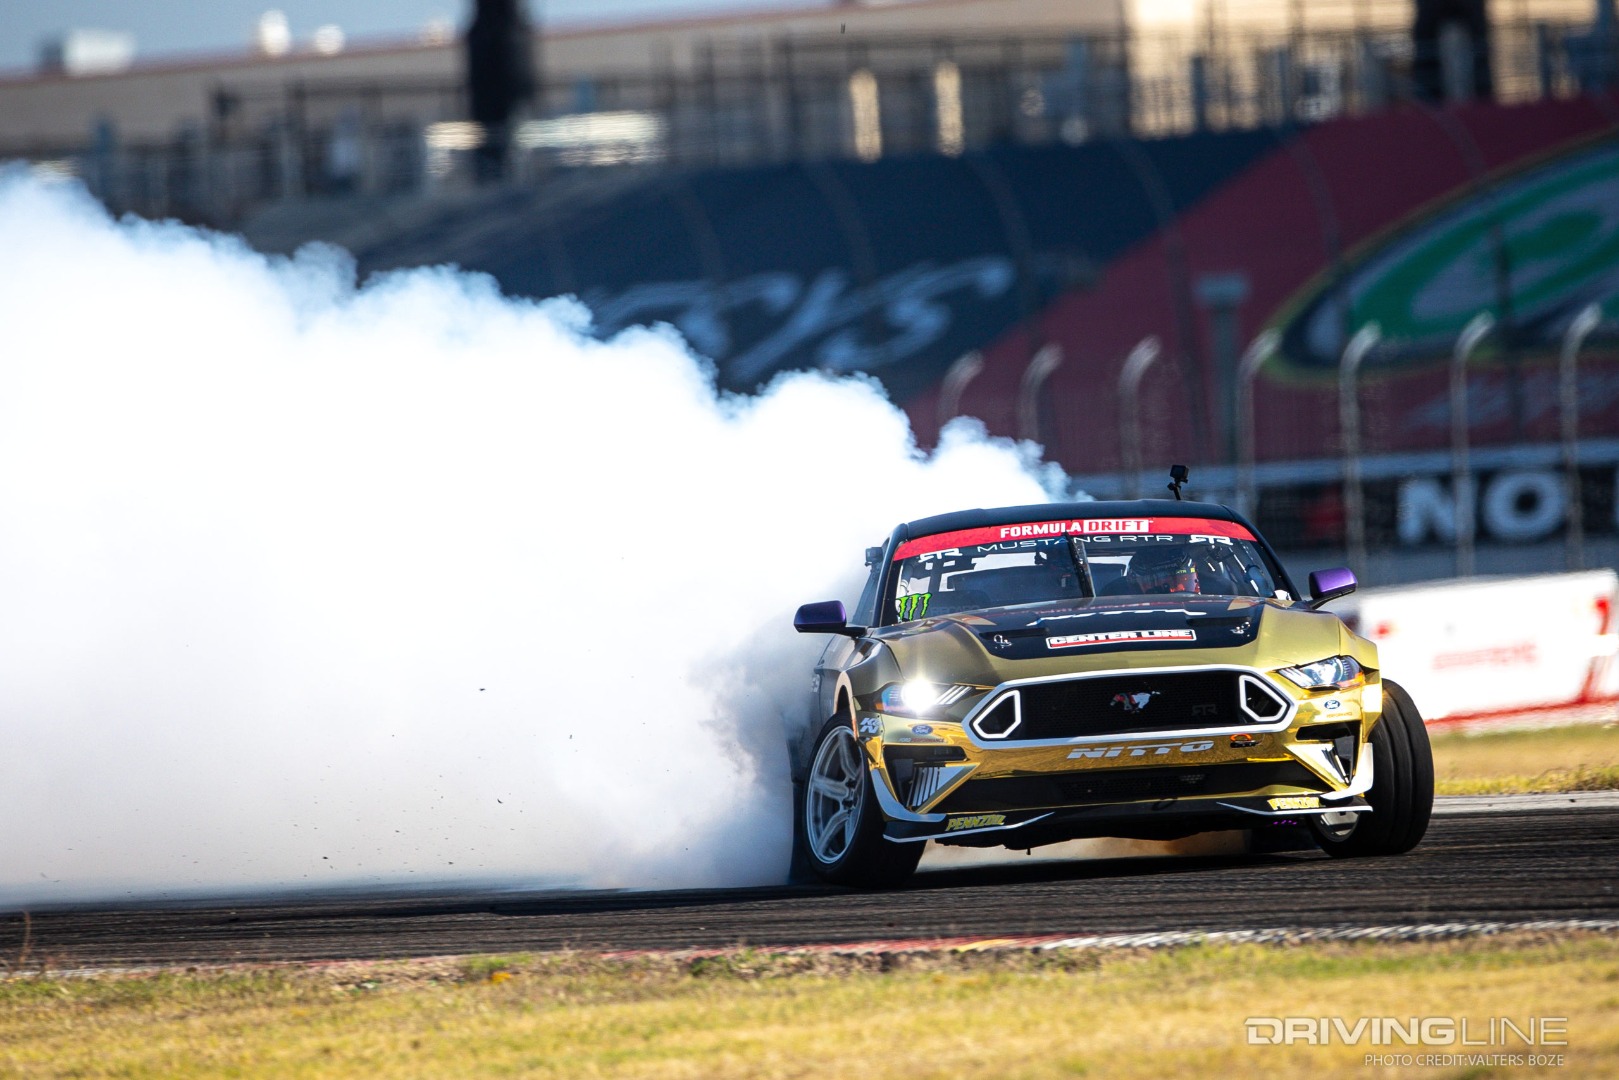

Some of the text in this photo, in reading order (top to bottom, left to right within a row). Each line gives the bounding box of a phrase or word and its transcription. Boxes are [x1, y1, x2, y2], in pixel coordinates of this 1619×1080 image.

[1000, 520, 1145, 538] FORMULA DRIFT
[977, 535, 1111, 553] MUSTANG
[1067, 740, 1215, 759] NITTO
[945, 814, 1007, 831] PENNZOIL
